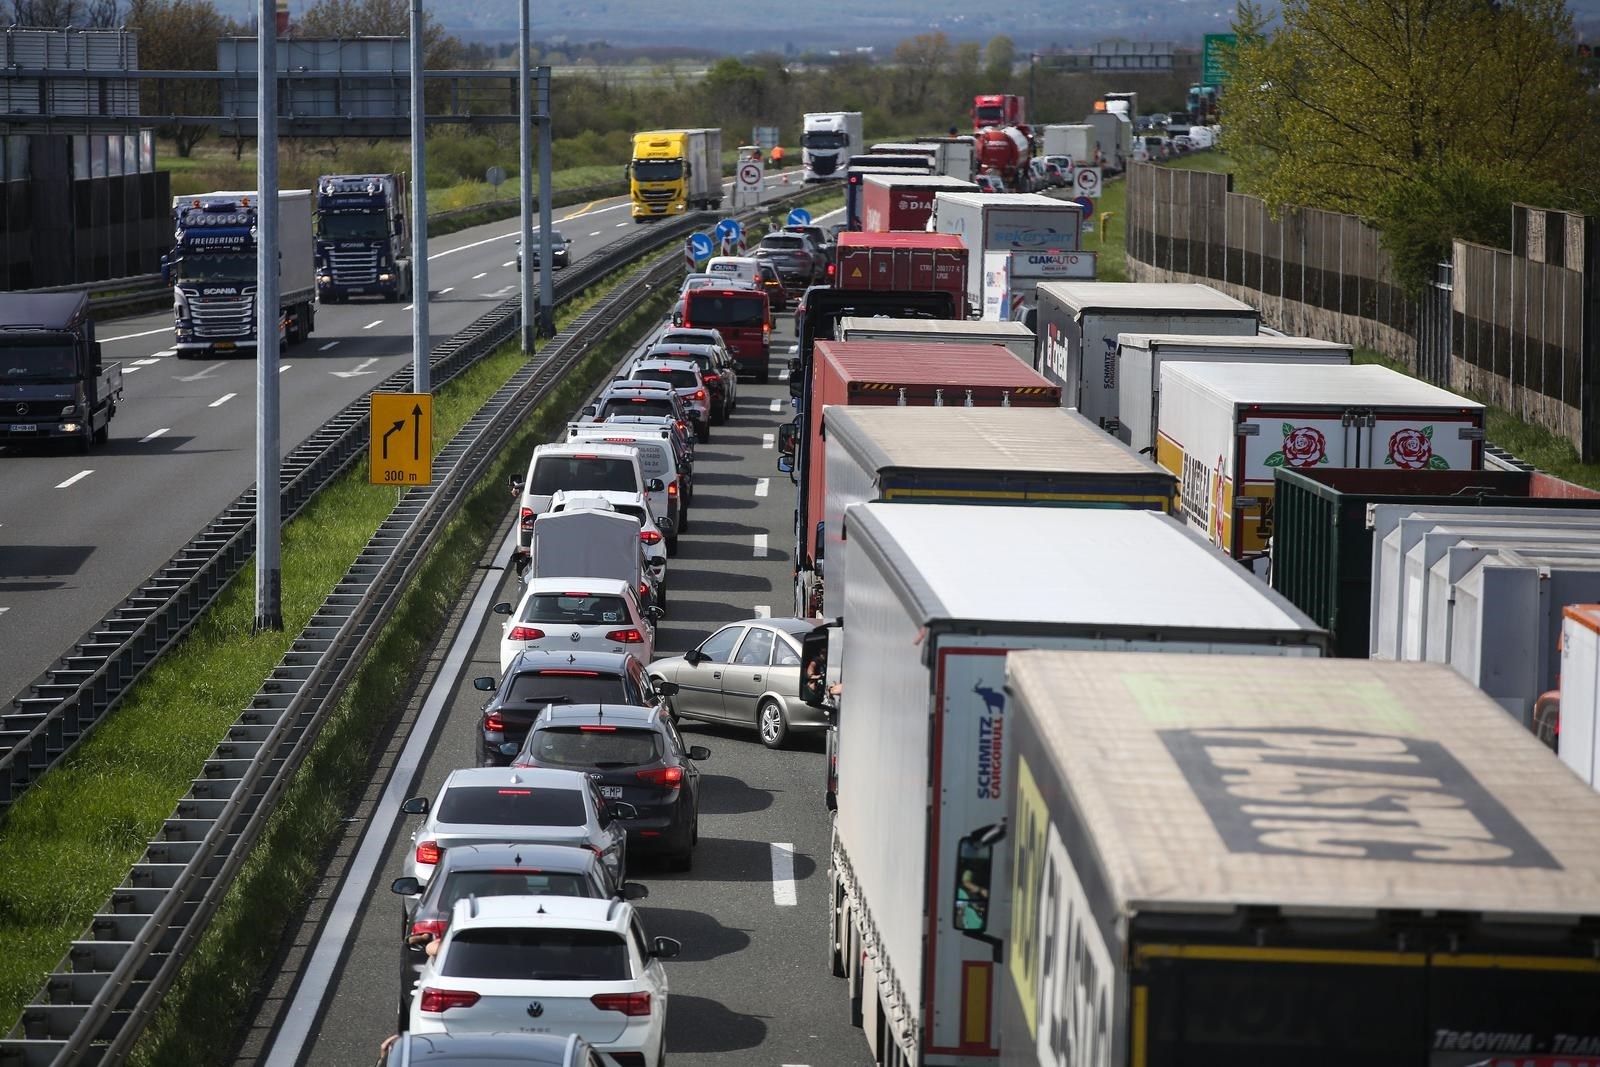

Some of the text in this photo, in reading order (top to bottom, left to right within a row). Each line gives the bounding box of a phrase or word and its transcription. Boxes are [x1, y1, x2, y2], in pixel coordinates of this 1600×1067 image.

[203, 287, 237, 295] SCANIA
[384, 470, 417, 481] 300 m
[977, 716, 993, 799] SCHMITZ
[991, 716, 1003, 799] CARGOBULL
[1432, 1029, 1534, 1052] TRGOVINA
